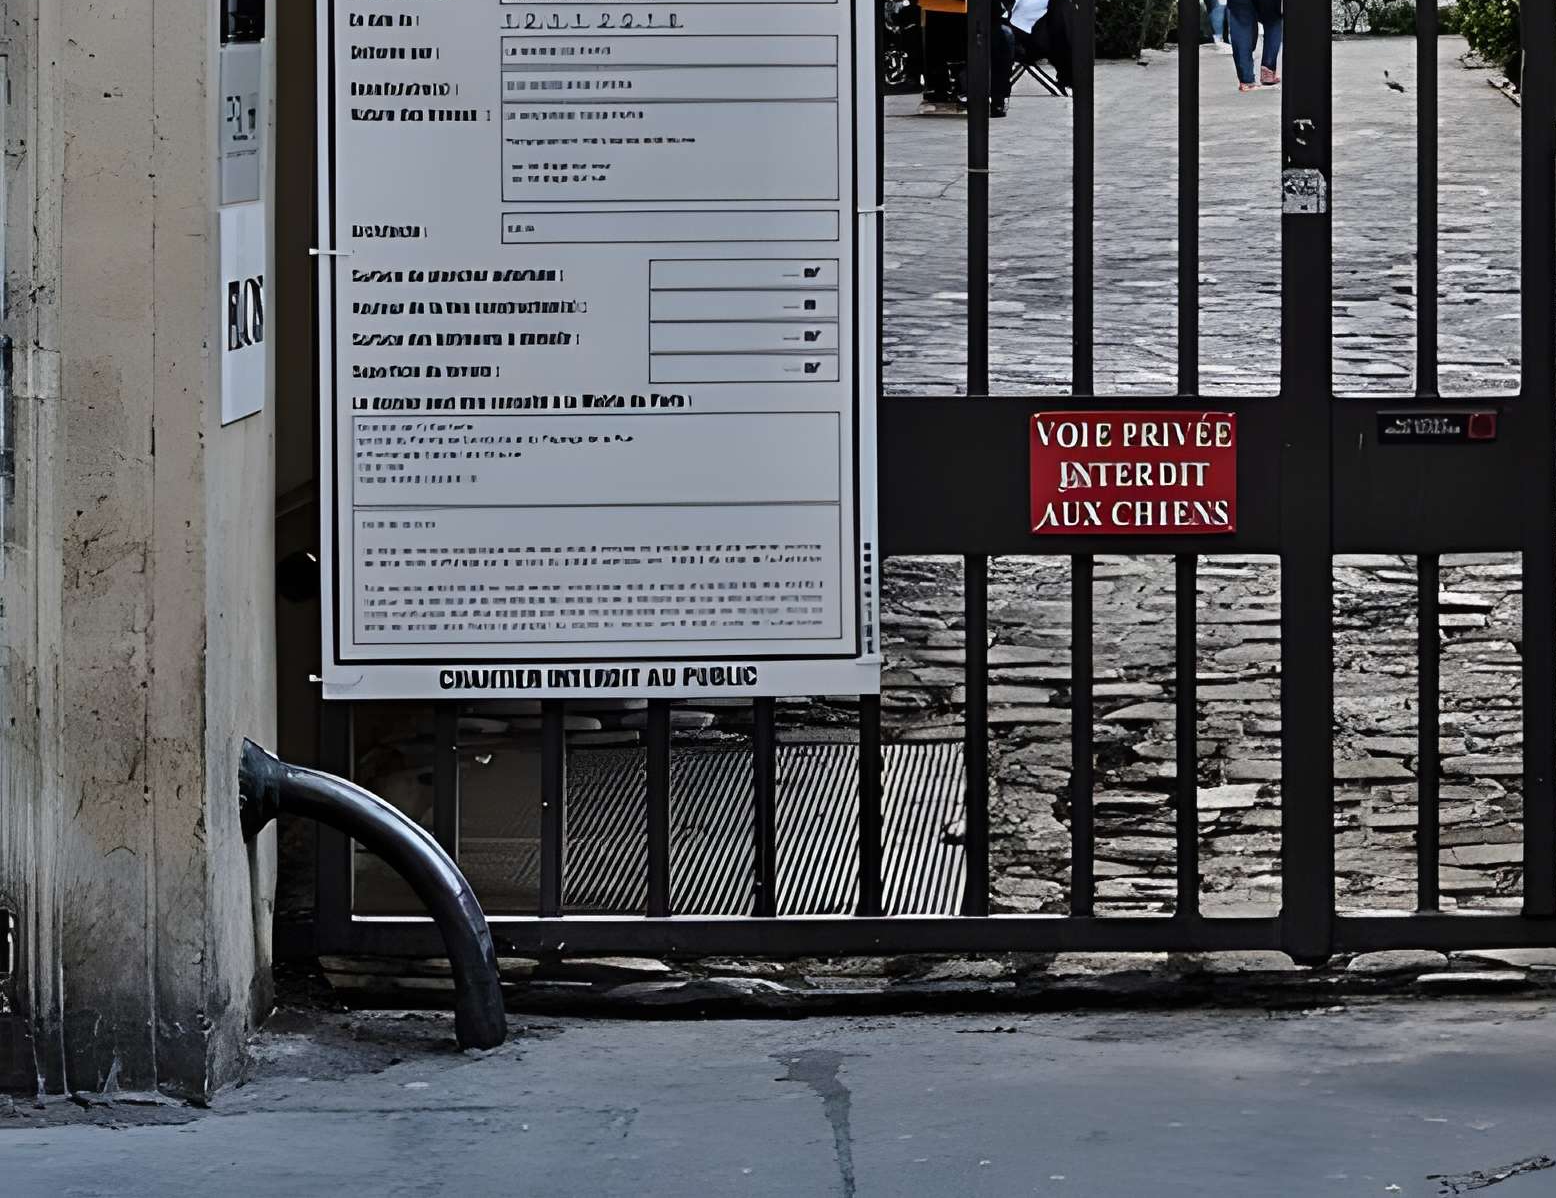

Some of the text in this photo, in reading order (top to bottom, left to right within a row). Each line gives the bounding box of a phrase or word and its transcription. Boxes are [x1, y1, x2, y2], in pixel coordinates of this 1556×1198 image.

[1036, 412, 1232, 448] VOIE PRIVÉE
[1057, 461, 1211, 493] INTERDIT
[1032, 500, 1230, 532] AUX CHIENS
